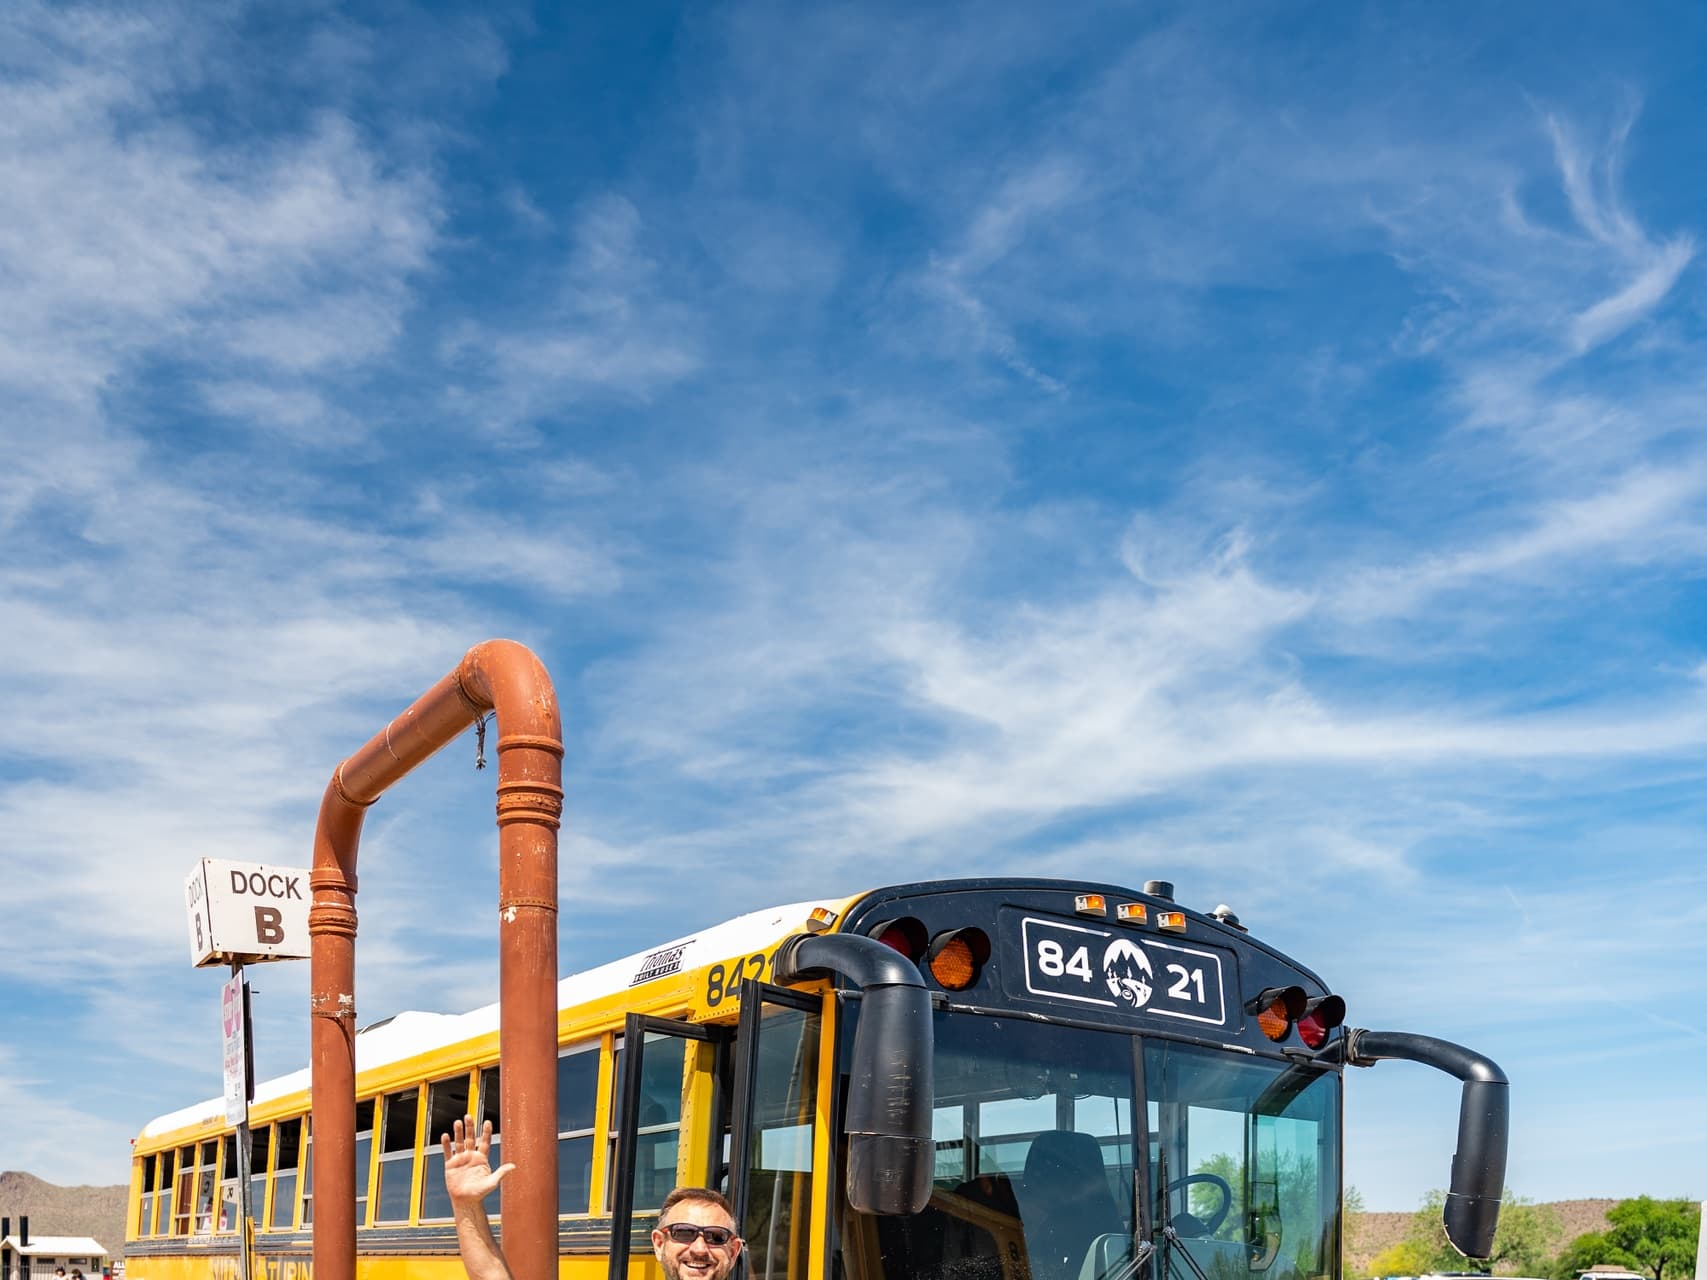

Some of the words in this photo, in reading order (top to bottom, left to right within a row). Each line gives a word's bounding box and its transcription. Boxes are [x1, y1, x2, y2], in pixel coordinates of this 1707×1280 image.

[230, 870, 302, 900] DOCK
[195, 912, 203, 952] B
[254, 906, 284, 944] B
[1037, 940, 1093, 983] 84
[1166, 963, 1205, 1004] 21
